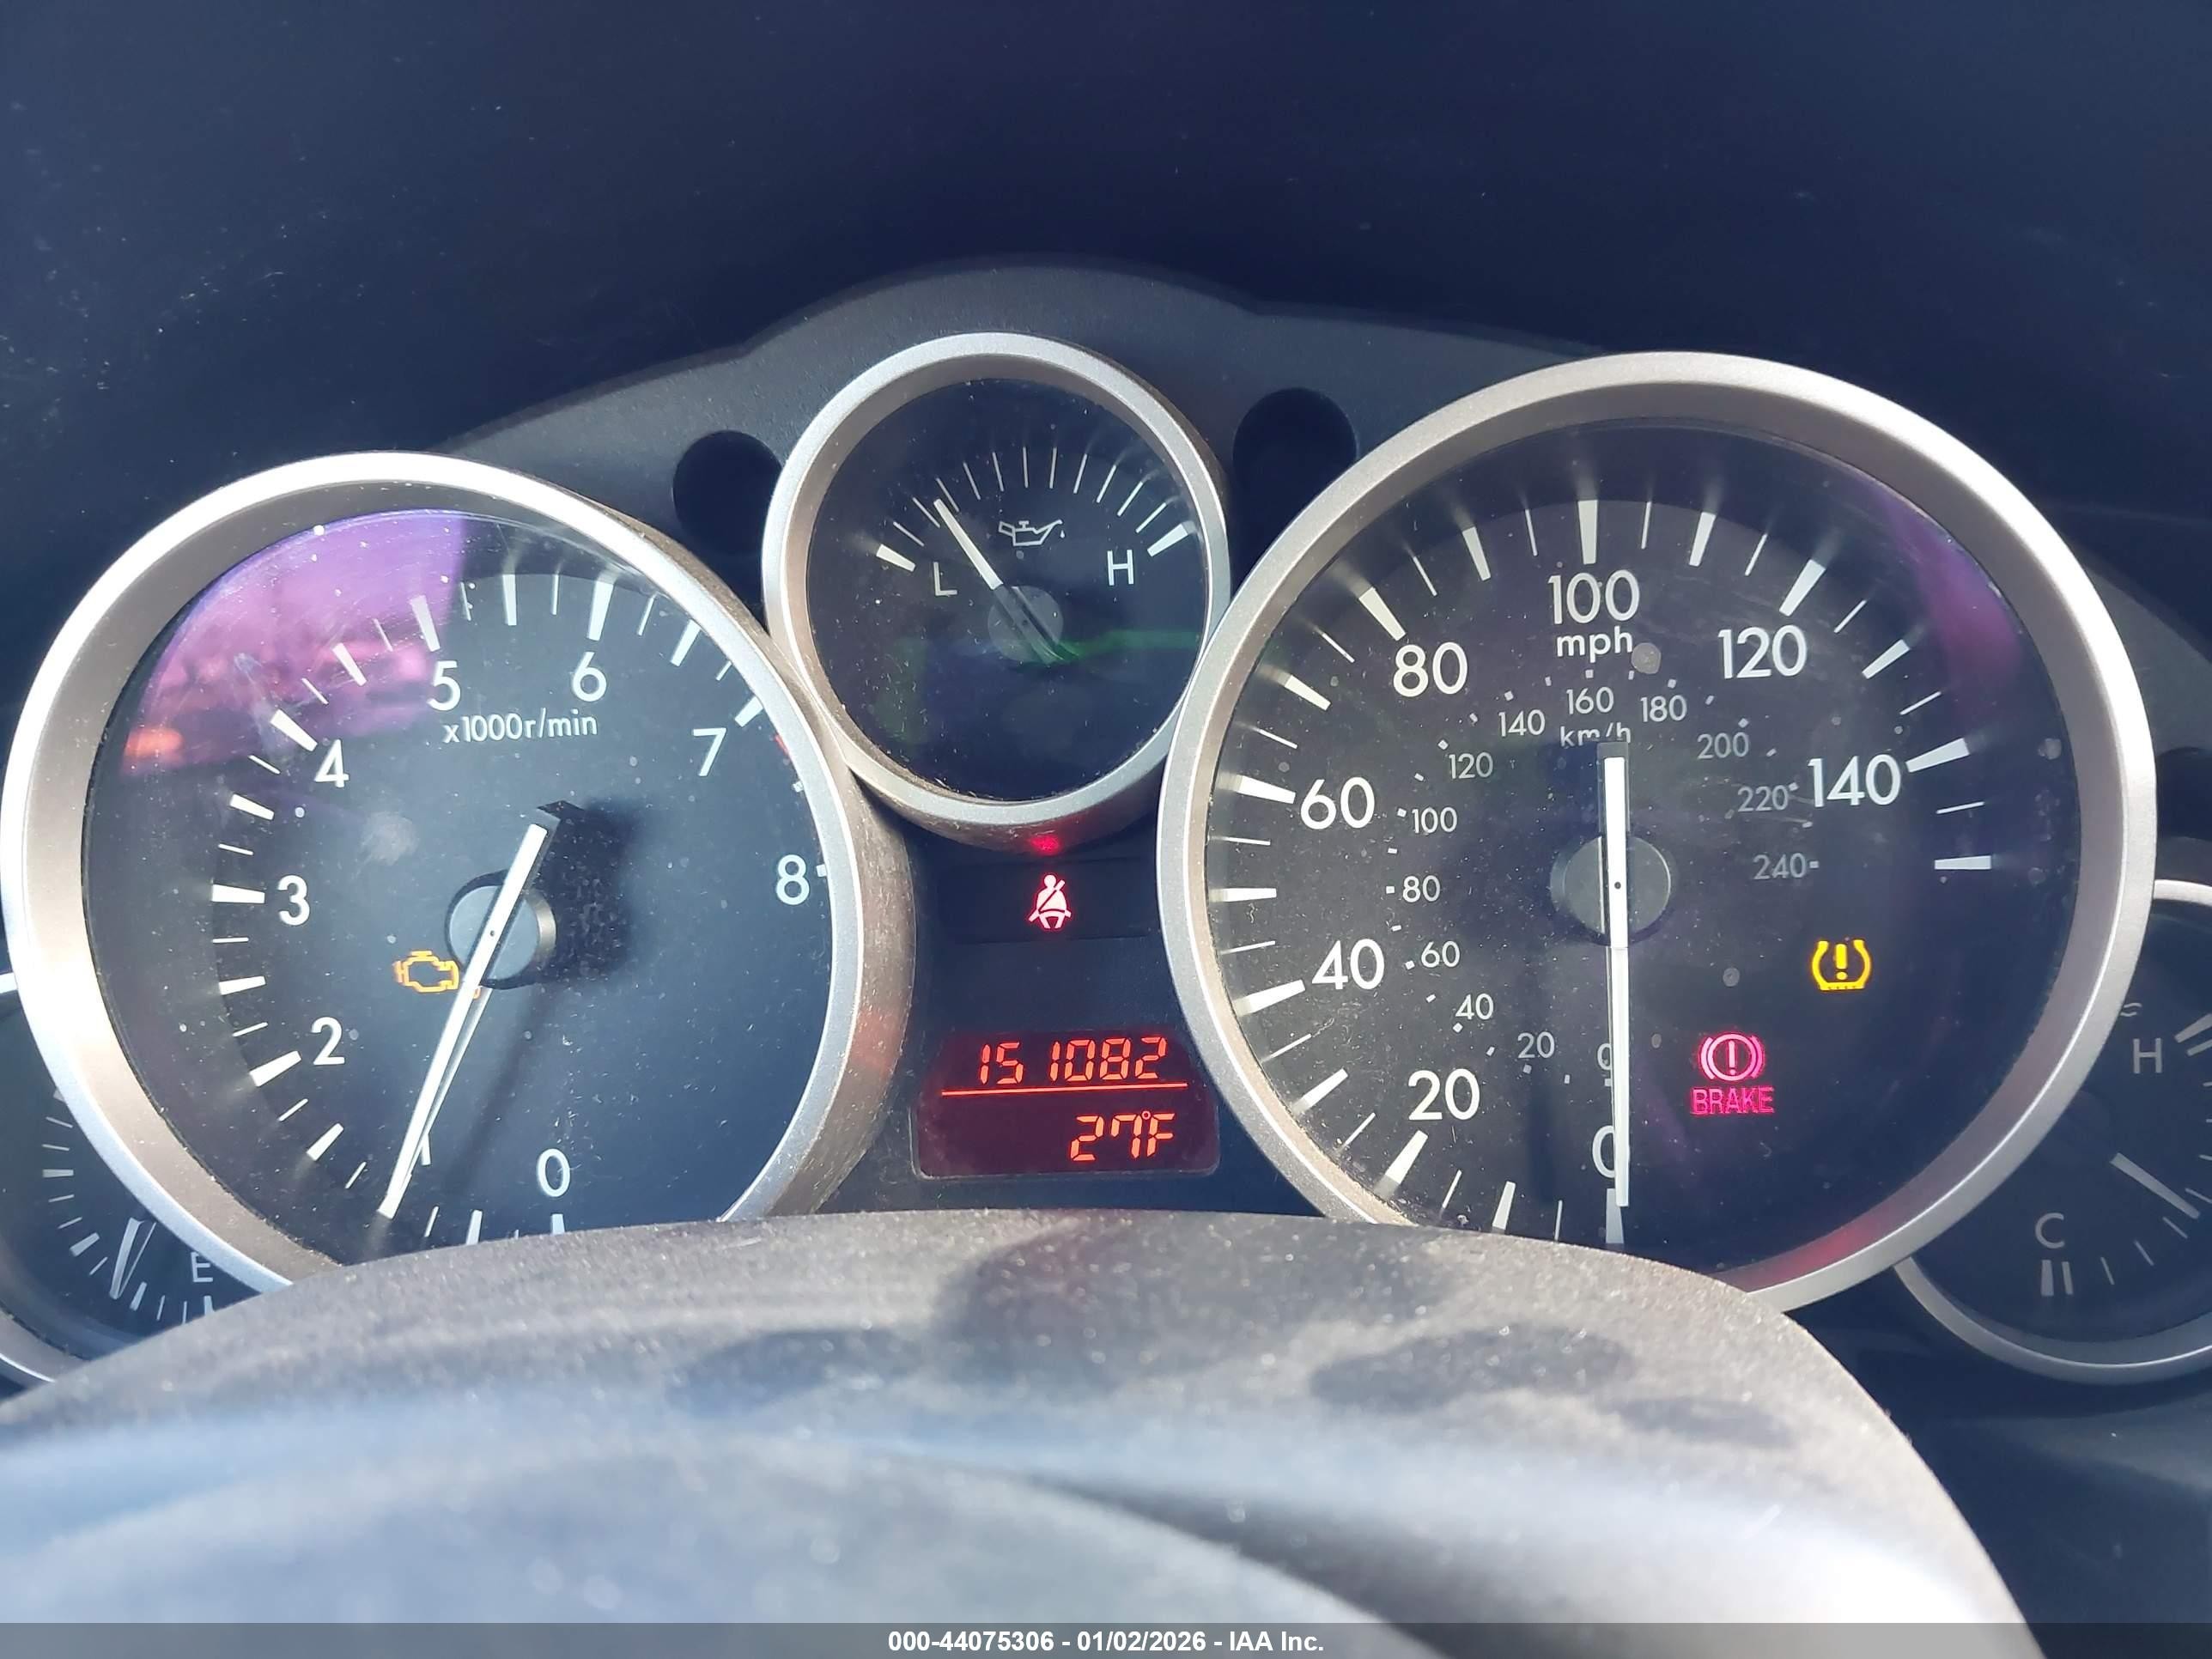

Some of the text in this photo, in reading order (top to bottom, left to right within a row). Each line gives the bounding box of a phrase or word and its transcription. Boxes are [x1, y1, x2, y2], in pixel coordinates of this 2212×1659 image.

[933, 562, 957, 597] L
[1108, 550, 1133, 586] H
[1548, 570, 1639, 624] 100
[1557, 626, 1632, 659] mph
[1718, 625, 1808, 678] 120
[427, 660, 460, 710] 5
[572, 652, 606, 702] 6
[1394, 642, 1468, 696] 80
[1566, 687, 1613, 714] 160
[1640, 696, 1686, 722] 180
[1498, 709, 1545, 736] 140
[1560, 722, 1631, 747] km/h
[693, 727, 726, 776] 7
[1697, 732, 1749, 759] 200
[314, 749, 349, 787] 4
[1449, 752, 1493, 779] 120
[1808, 755, 1900, 807] 140
[1301, 777, 1375, 830] 60
[1738, 787, 1789, 811] 220
[1412, 807, 1457, 835] 100
[776, 854, 809, 905] 8
[1753, 854, 1806, 879] 240
[277, 875, 309, 925] 3
[1403, 876, 1440, 902] 80
[1312, 939, 1384, 989] 40
[1421, 941, 1460, 967] 60
[1455, 994, 1493, 1019] 40
[312, 1017, 344, 1065] 2
[1518, 1031, 1554, 1058] 20
[2133, 1037, 2162, 1074] H
[1408, 1069, 1480, 1120] 20
[1691, 1085, 1773, 1115] BRAKE
[537, 1149, 570, 1197] 0
[2035, 1212, 2065, 1249] C
[191, 1251, 214, 1282] E
